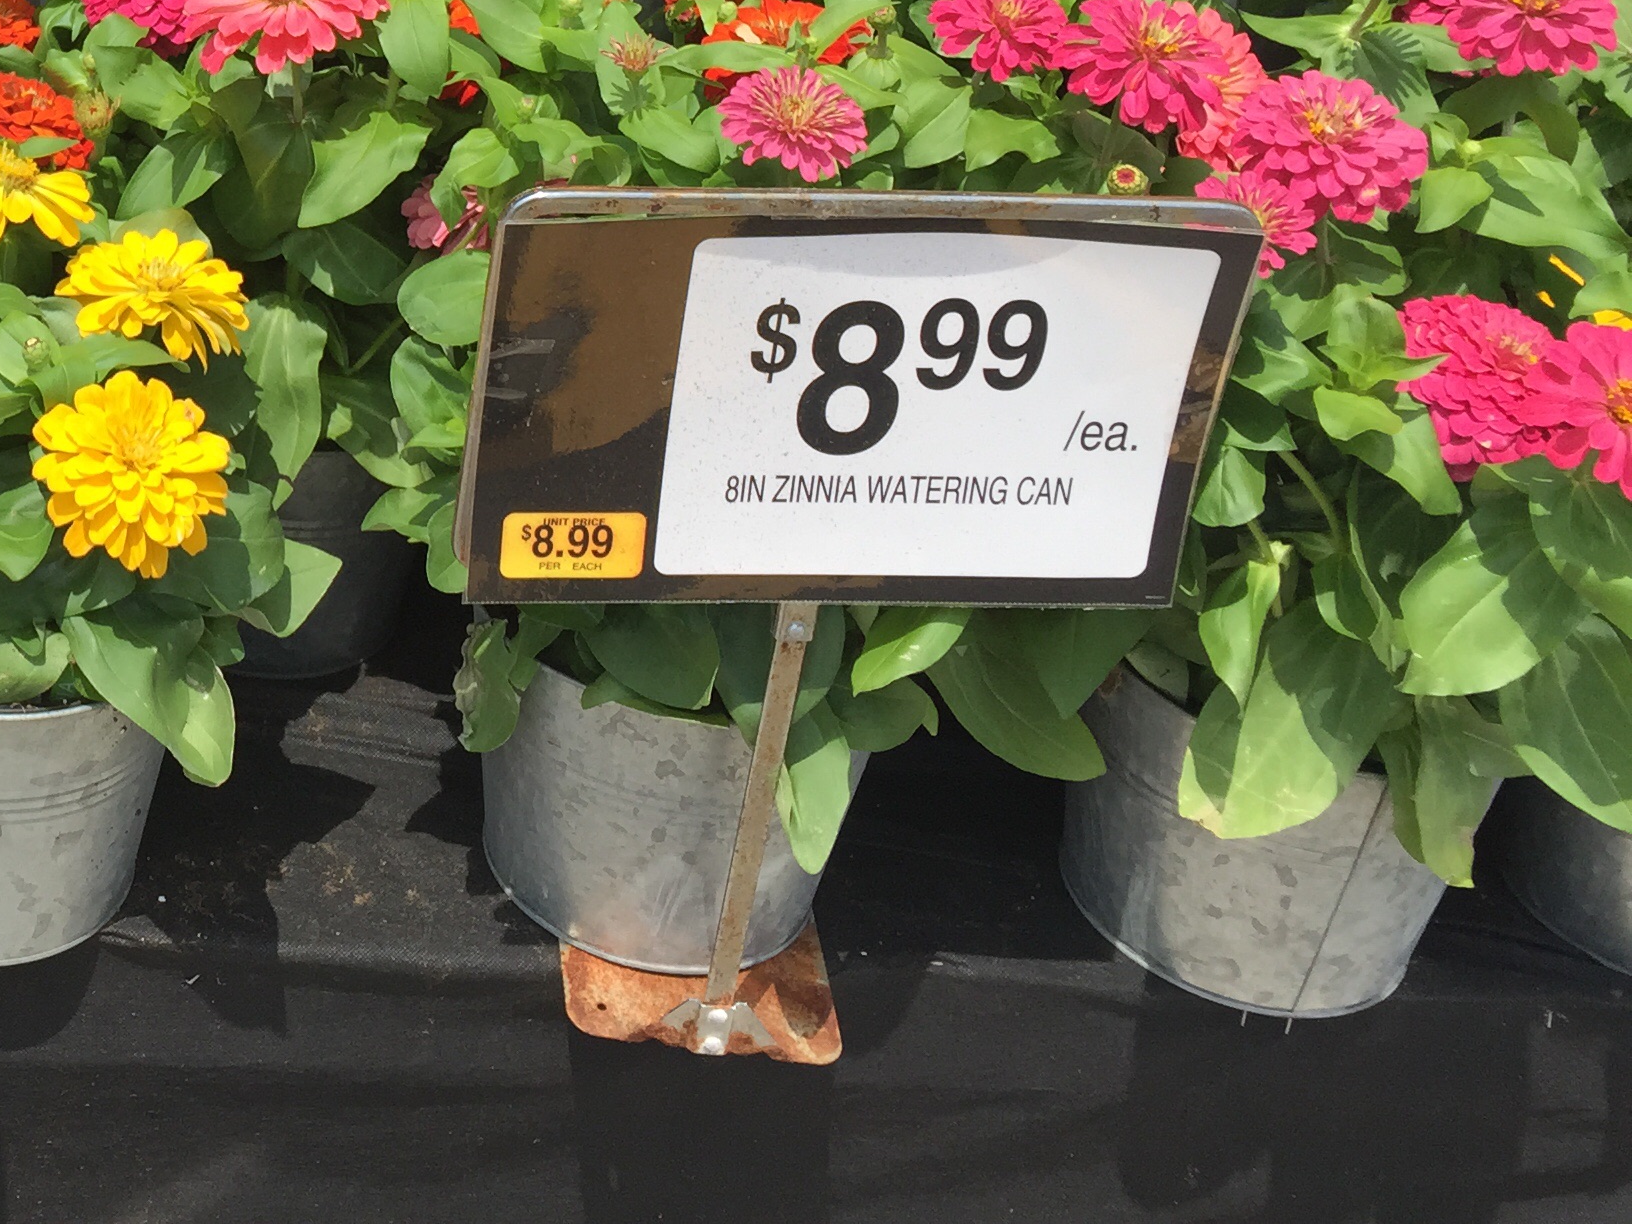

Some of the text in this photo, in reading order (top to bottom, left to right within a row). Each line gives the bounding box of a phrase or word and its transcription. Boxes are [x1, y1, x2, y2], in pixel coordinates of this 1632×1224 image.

[1063, 410, 1139, 453] /ea.
[725, 474, 1074, 506] 8IN ZINNIA WATERING CAN
[542, 517, 606, 526] UNIT PRICE
[521, 524, 613, 558] $8.99
[538, 561, 602, 571] PER EACH
